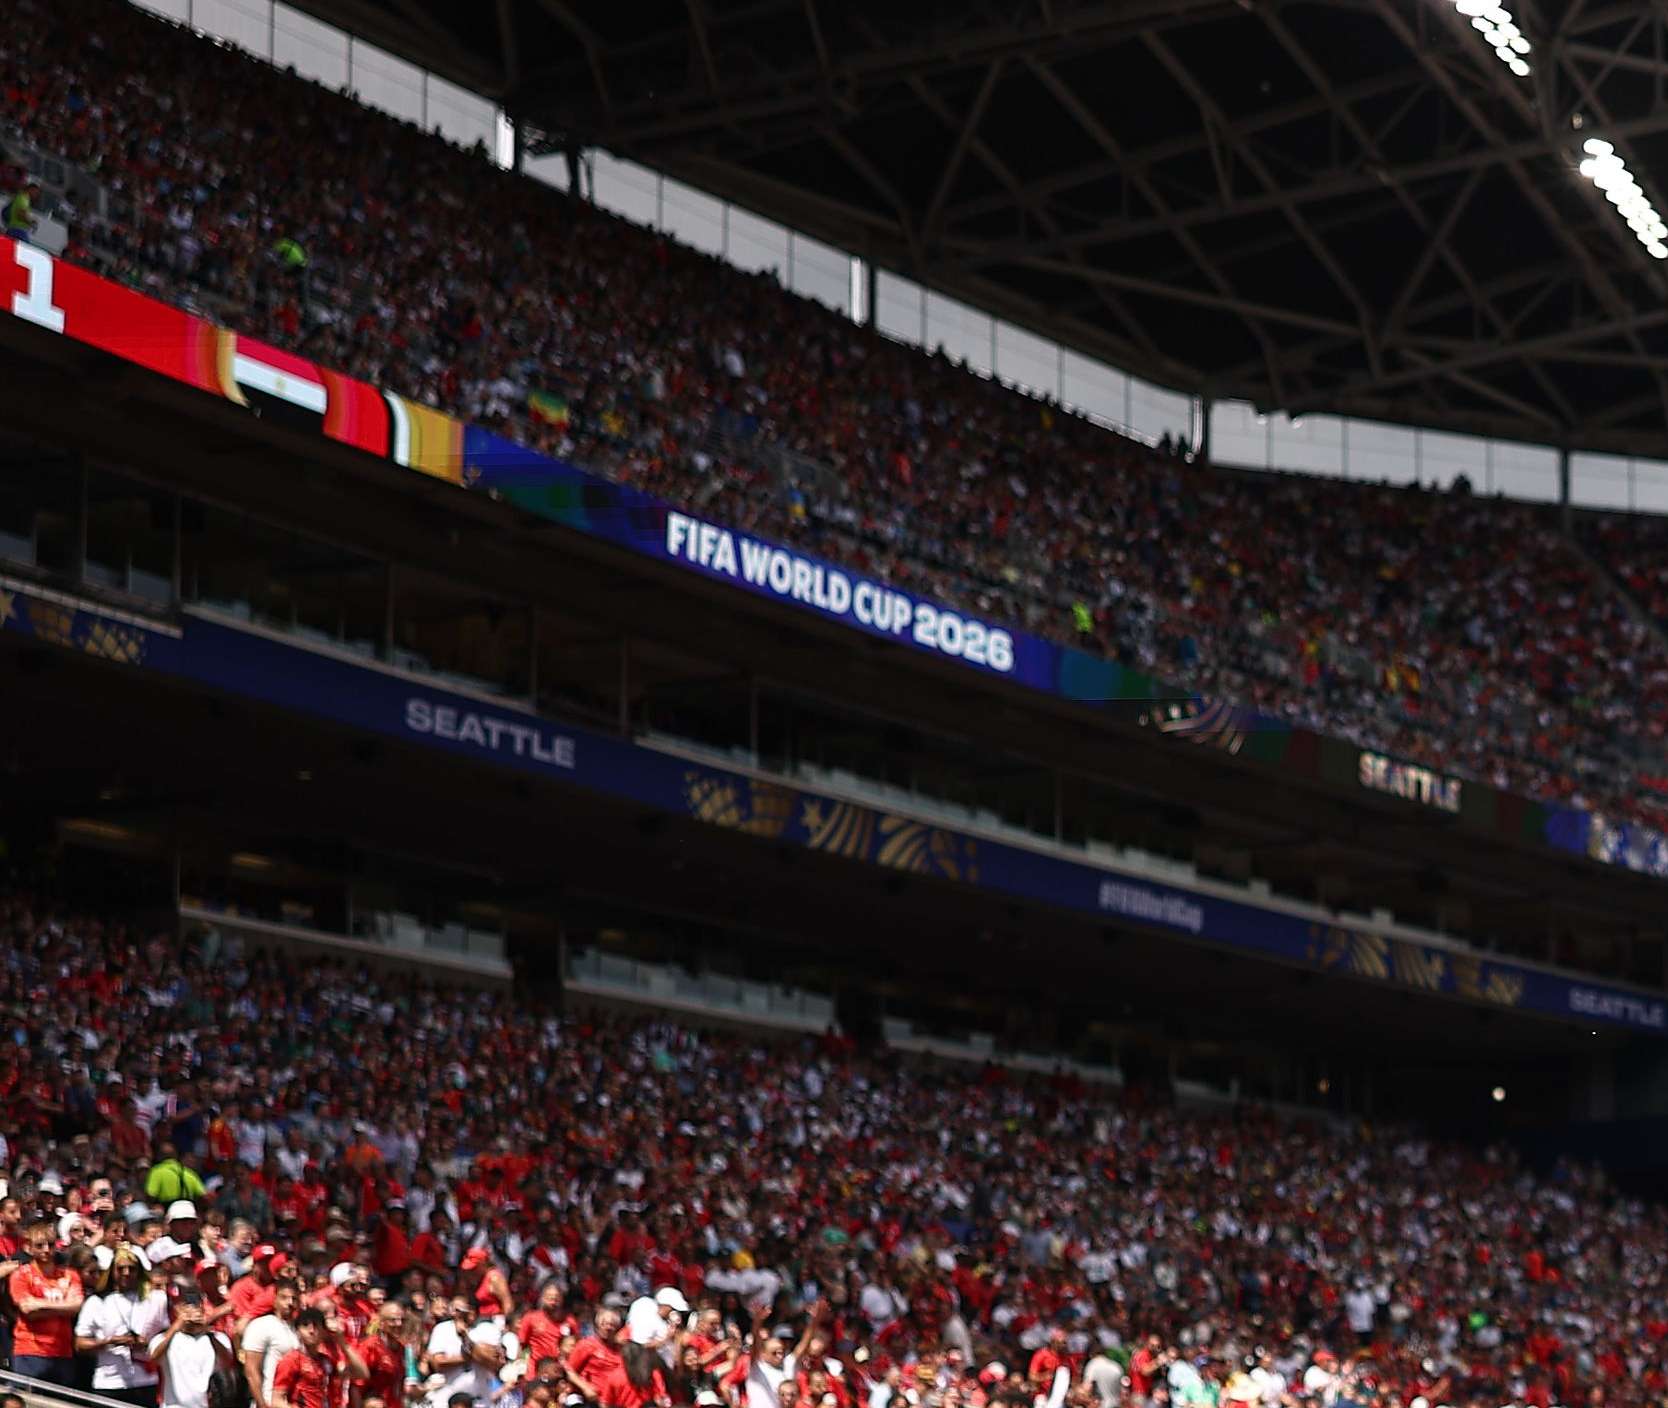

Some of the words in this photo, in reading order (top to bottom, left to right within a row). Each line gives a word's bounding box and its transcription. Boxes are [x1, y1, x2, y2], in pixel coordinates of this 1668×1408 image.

[13, 239, 65, 334] 1
[666, 511, 738, 577] FIFA
[739, 538, 851, 614] WORLD
[853, 581, 913, 634] CUP
[912, 603, 1014, 672] 2026
[405, 698, 576, 769] SEATTLE
[1358, 751, 1463, 813] SEATTLE
[1568, 987, 1665, 1027] SEATTLE
